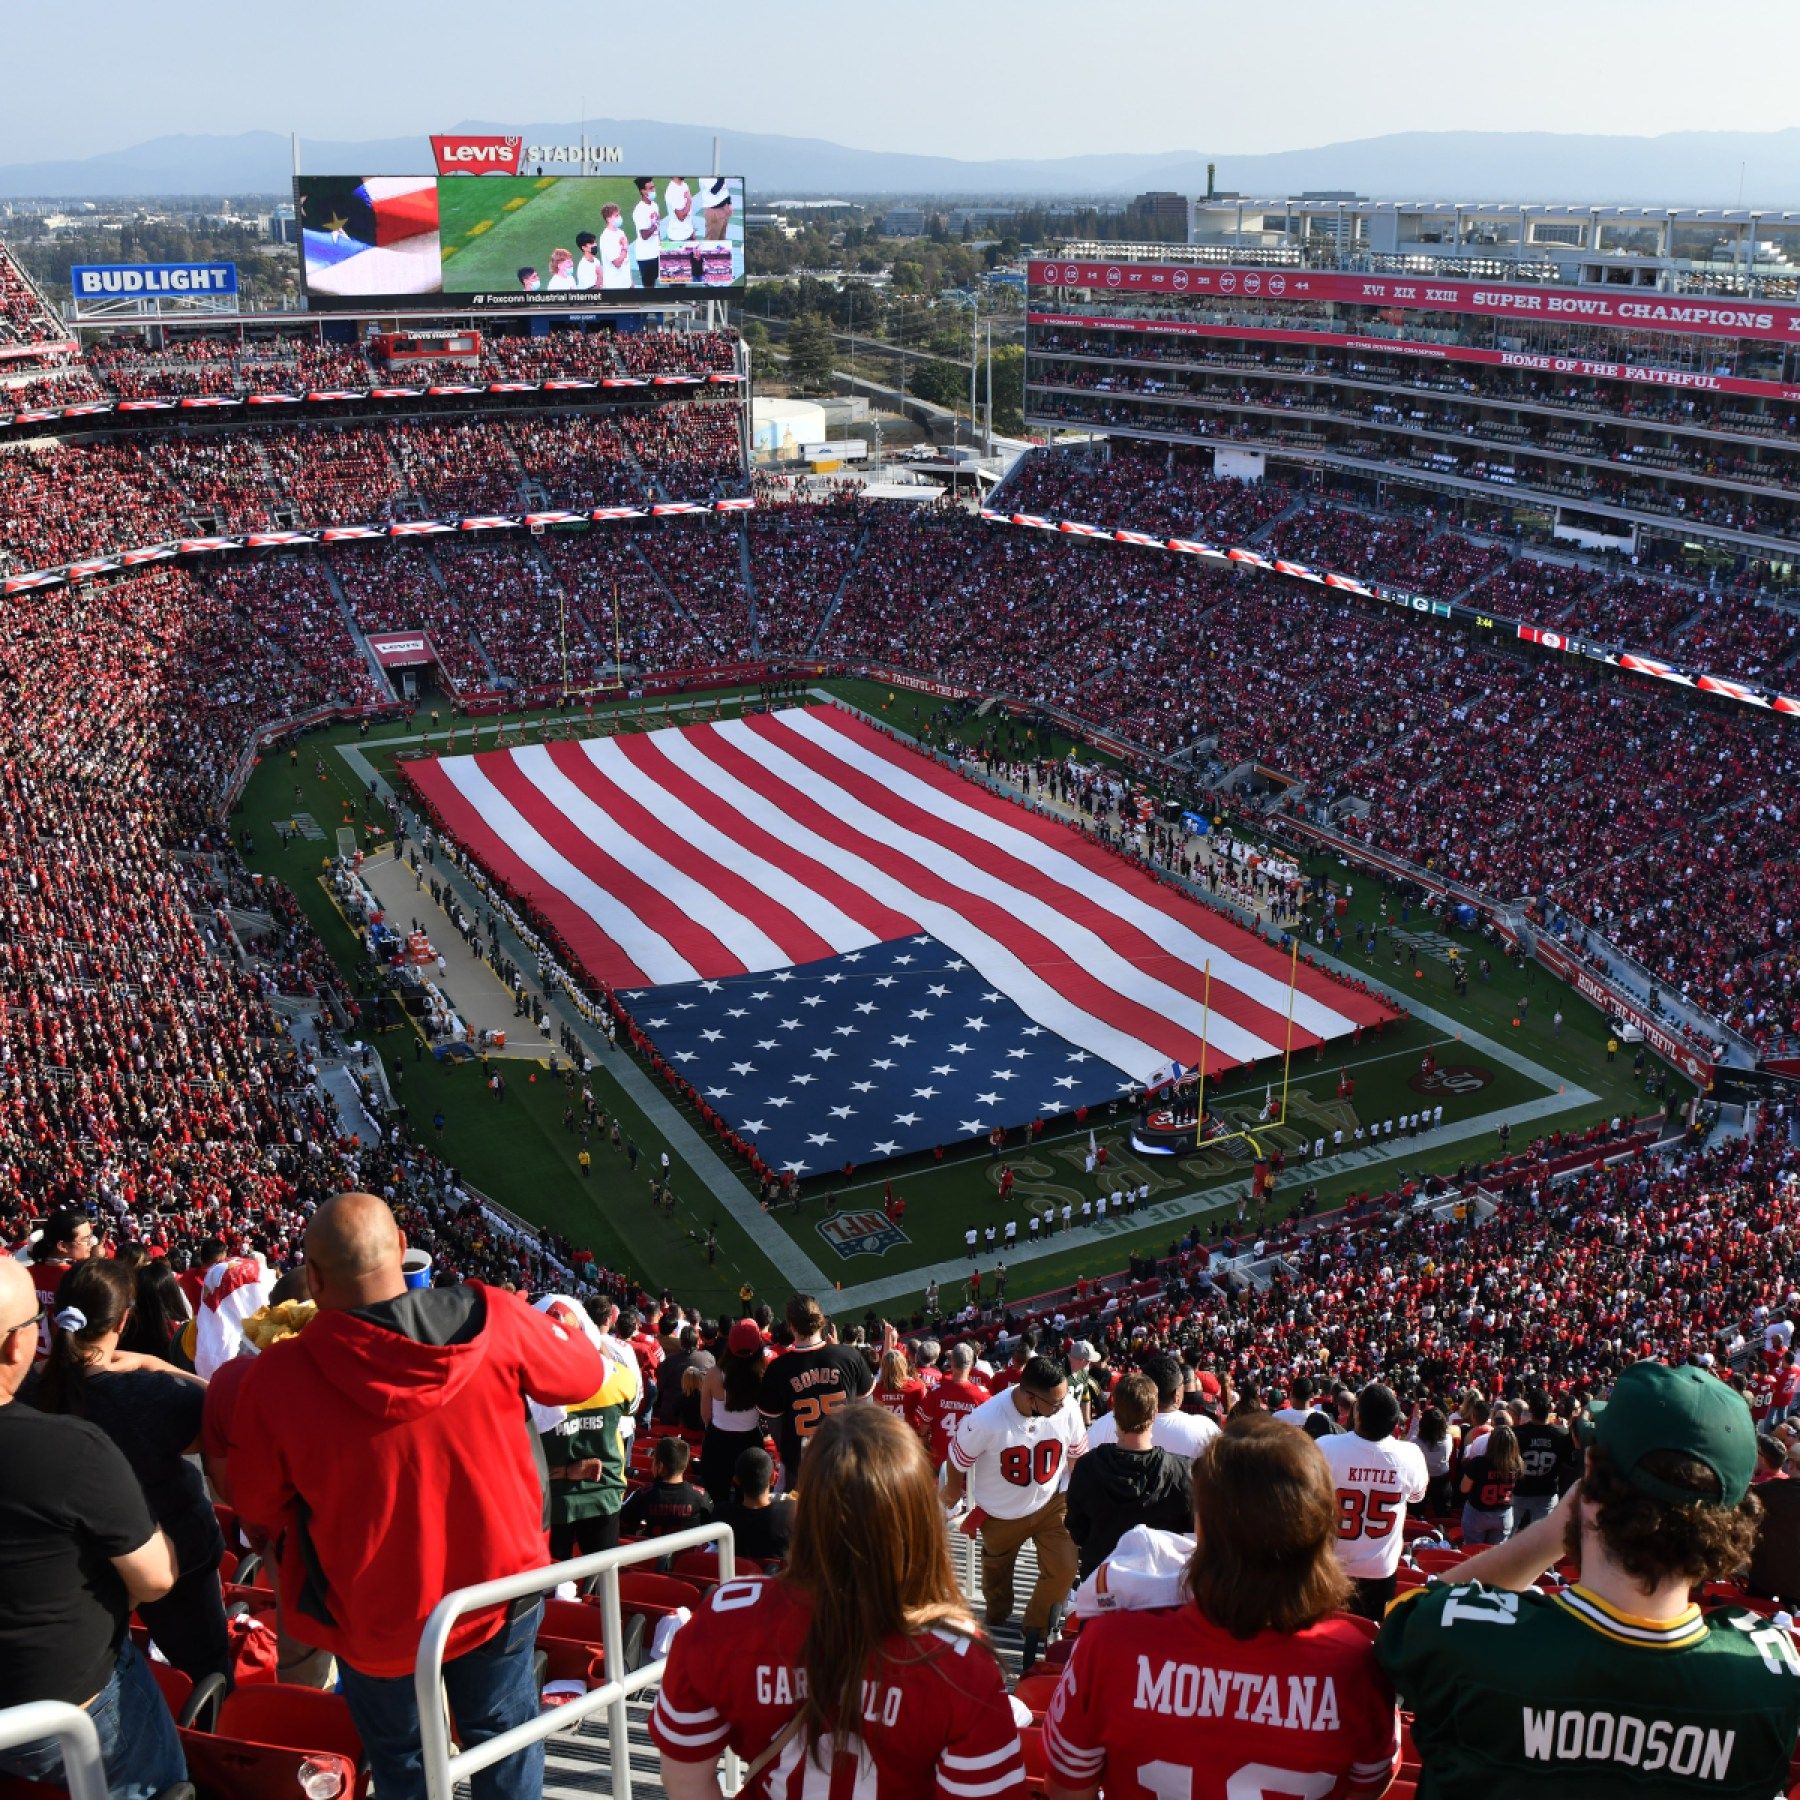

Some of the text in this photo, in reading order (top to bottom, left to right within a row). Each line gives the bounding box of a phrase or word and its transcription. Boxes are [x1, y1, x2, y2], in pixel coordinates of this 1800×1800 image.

[527, 146, 624, 163] STADIUM
[487, 294, 525, 304] Foxconn
[526, 293, 567, 302] Industrial
[569, 292, 602, 301] Internet
[1362, 284, 1385, 296] XVI
[1393, 286, 1417, 299] XIX
[1425, 289, 1458, 302] XXIII
[1472, 291, 1541, 309] SUPER
[1547, 297, 1613, 316] BOWL
[1618, 302, 1774, 330] CHAMPIONS
[1502, 353, 1720, 390] HOME OF THE FAITHFUL
[892, 673, 932, 691] FAITHFUL
[1577, 972, 1604, 1003] HOME
[1629, 1011, 1678, 1061] FAITHFUL
[1149, 1203, 1187, 1221] OF
[822, 1213, 891, 1241] NFL
[790, 1367, 840, 1393] BONDS
[555, 1415, 604, 1436] PACKERS
[1000, 1438, 1063, 1487] 80
[1348, 1466, 1397, 1485] KITTLE
[1335, 1487, 1402, 1541] 85
[1133, 1654, 1341, 1732] MONTANA
[1523, 1706, 1736, 1781] WOODSON
